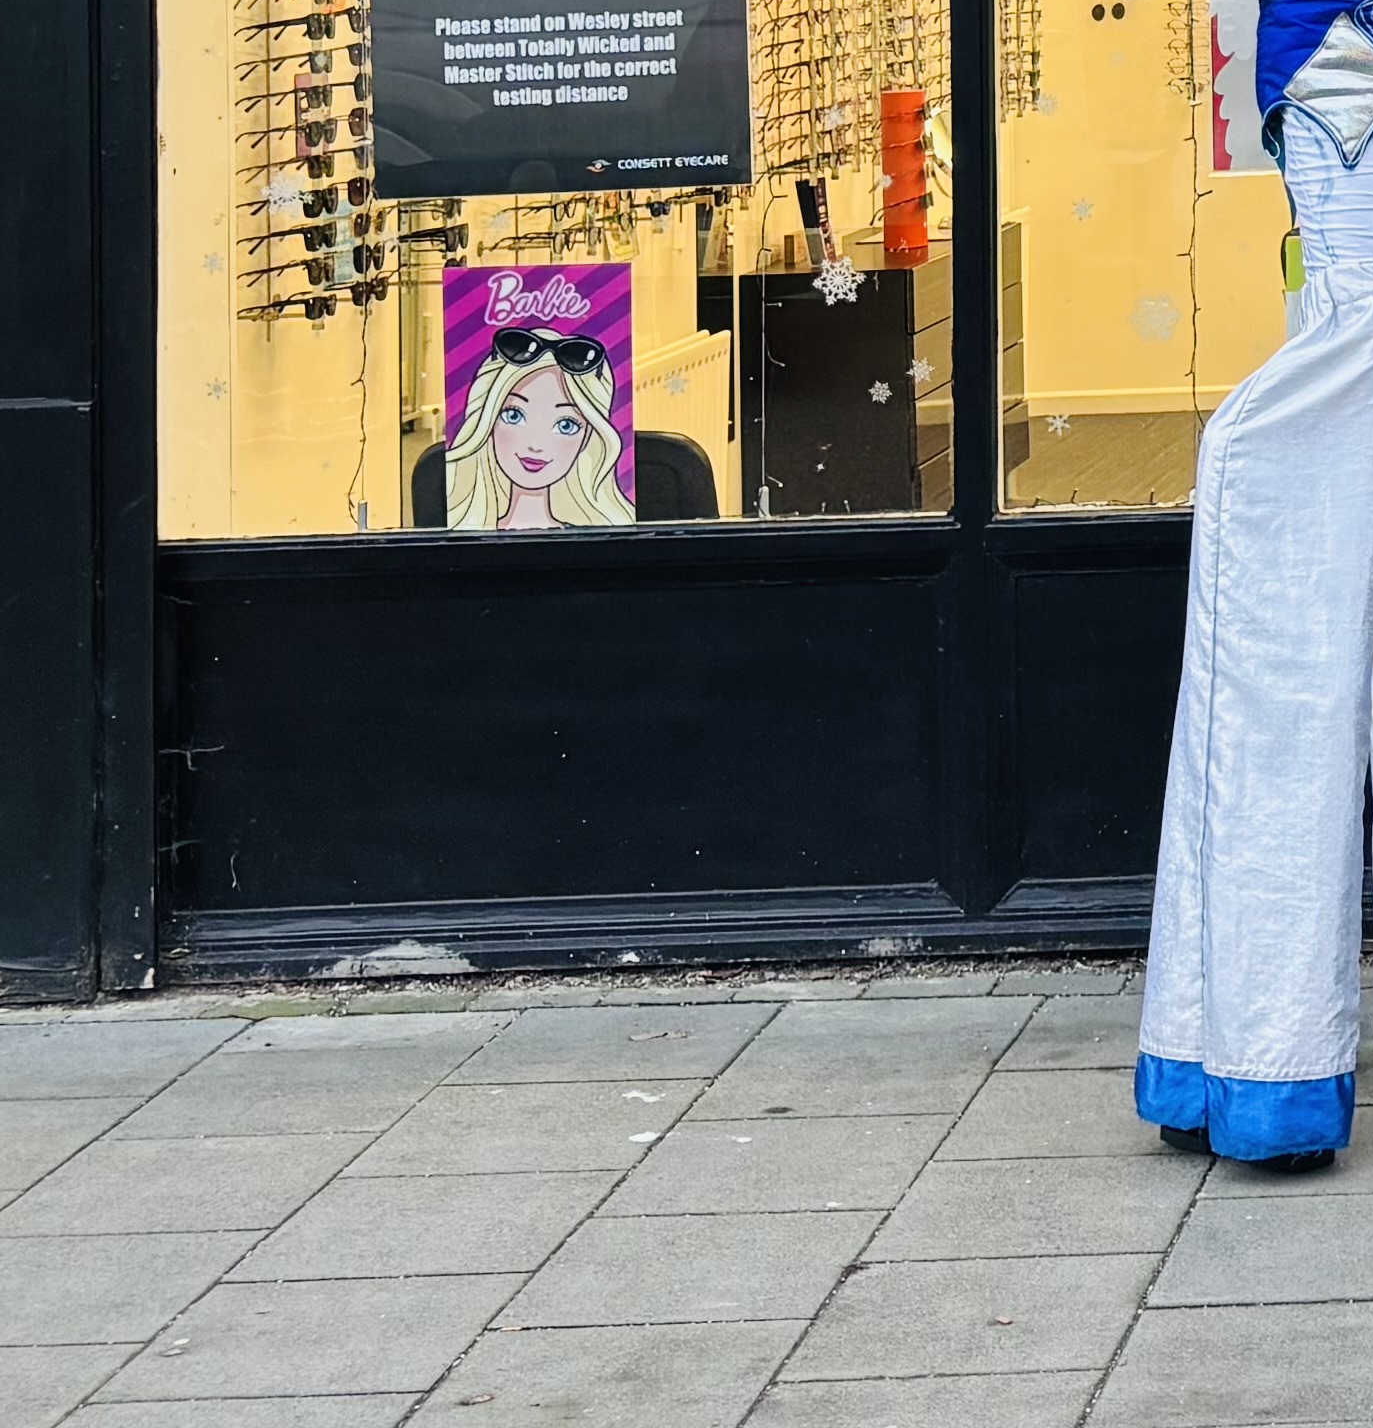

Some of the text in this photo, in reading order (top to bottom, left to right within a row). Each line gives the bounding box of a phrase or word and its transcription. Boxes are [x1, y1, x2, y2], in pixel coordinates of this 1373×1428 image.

[435, 10, 683, 36] Please stand on Wesley street
[444, 33, 675, 61] between Totally Wicked and
[444, 57, 677, 85] Master Stitch for the correct
[493, 83, 628, 107] testing distance
[617, 154, 729, 170] CONSETT EYECARE
[484, 270, 591, 326] Barbie
